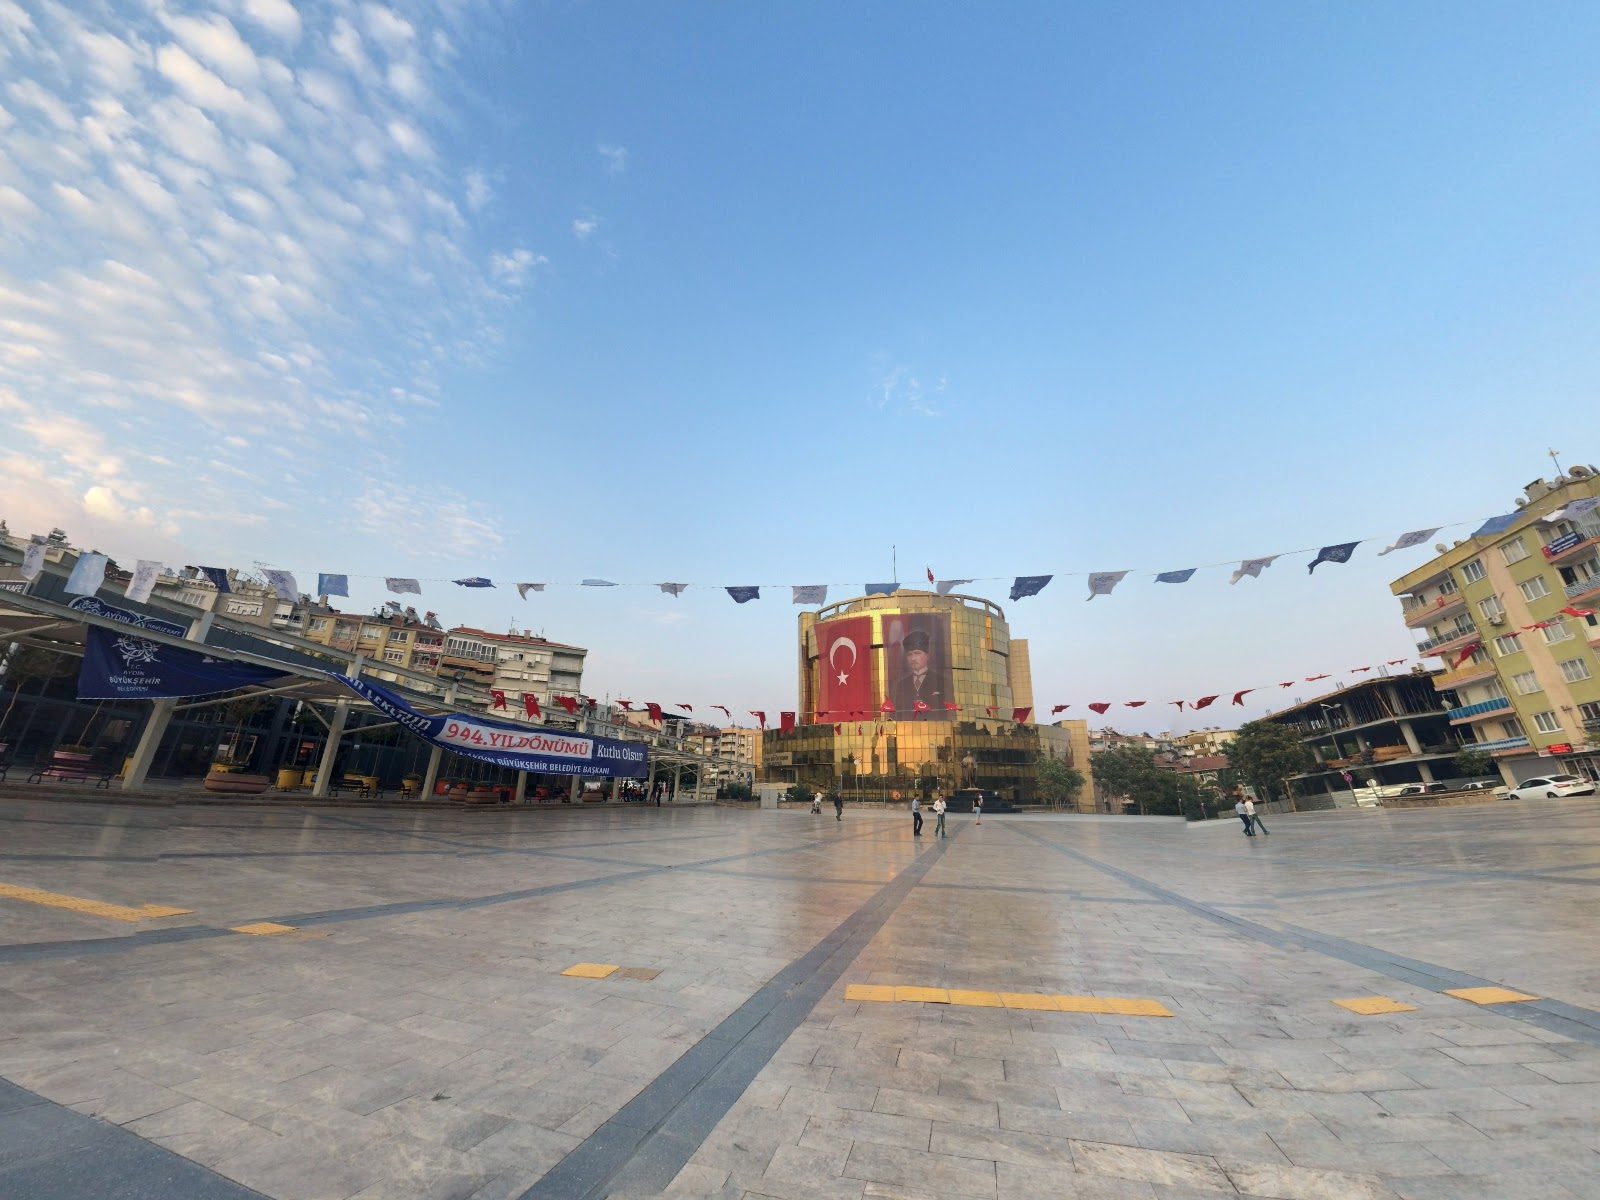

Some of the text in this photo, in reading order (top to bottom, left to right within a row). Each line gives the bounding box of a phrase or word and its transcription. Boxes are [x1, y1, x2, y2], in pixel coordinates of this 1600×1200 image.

[104, 611, 131, 624] AYDIN
[109, 675, 161, 686] BÜYÜKŞEHİR
[597, 744, 644, 761] Kutlu Olsun
[497, 757, 548, 771] BÜYÜKŞEHİR
[549, 763, 581, 773] BELEDİYE
[582, 766, 610, 775] BAŞKANI
